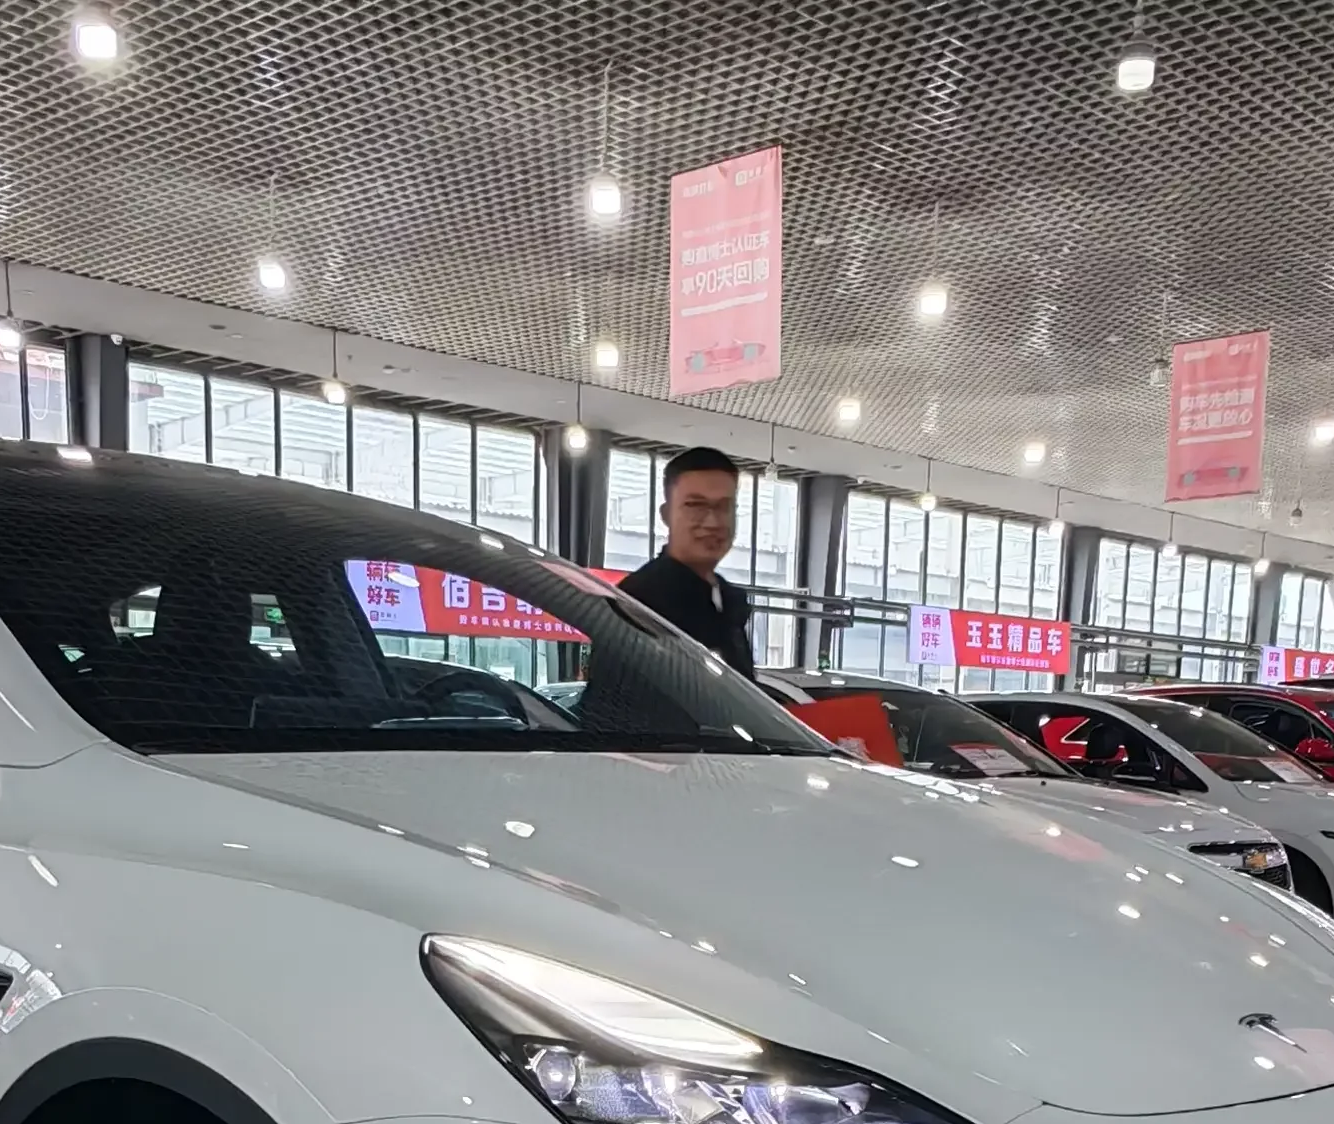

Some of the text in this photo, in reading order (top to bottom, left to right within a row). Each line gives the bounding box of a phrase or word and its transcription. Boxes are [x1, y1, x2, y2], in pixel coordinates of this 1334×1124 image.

[367, 585, 401, 607] 好车
[921, 631, 942, 649] 好车
[965, 620, 1063, 656] 玉玉精品车
